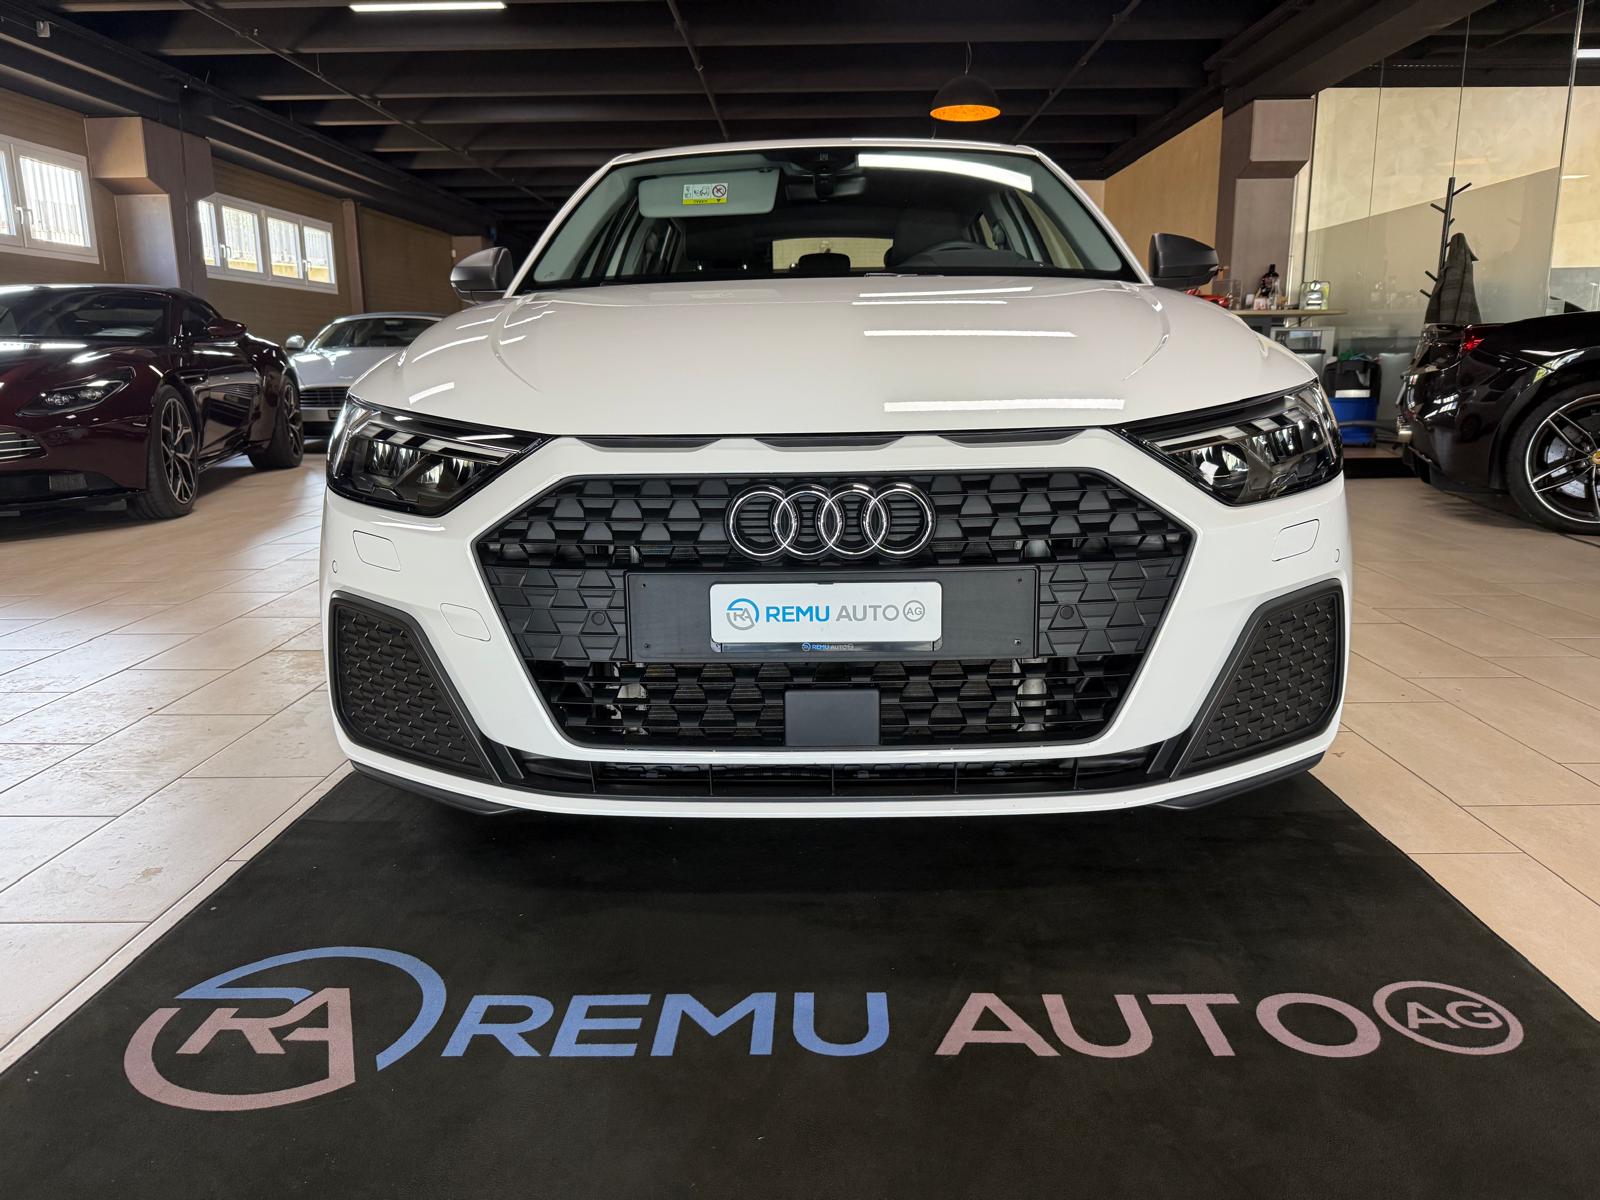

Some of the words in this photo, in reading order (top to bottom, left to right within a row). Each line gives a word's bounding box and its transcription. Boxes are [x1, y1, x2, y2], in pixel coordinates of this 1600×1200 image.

[766, 606, 829, 622] REMU
[836, 605, 899, 622] AUTO
[441, 992, 889, 1057] REMU
[935, 993, 1381, 1058] AUTO
[1407, 1001, 1503, 1029] AG
